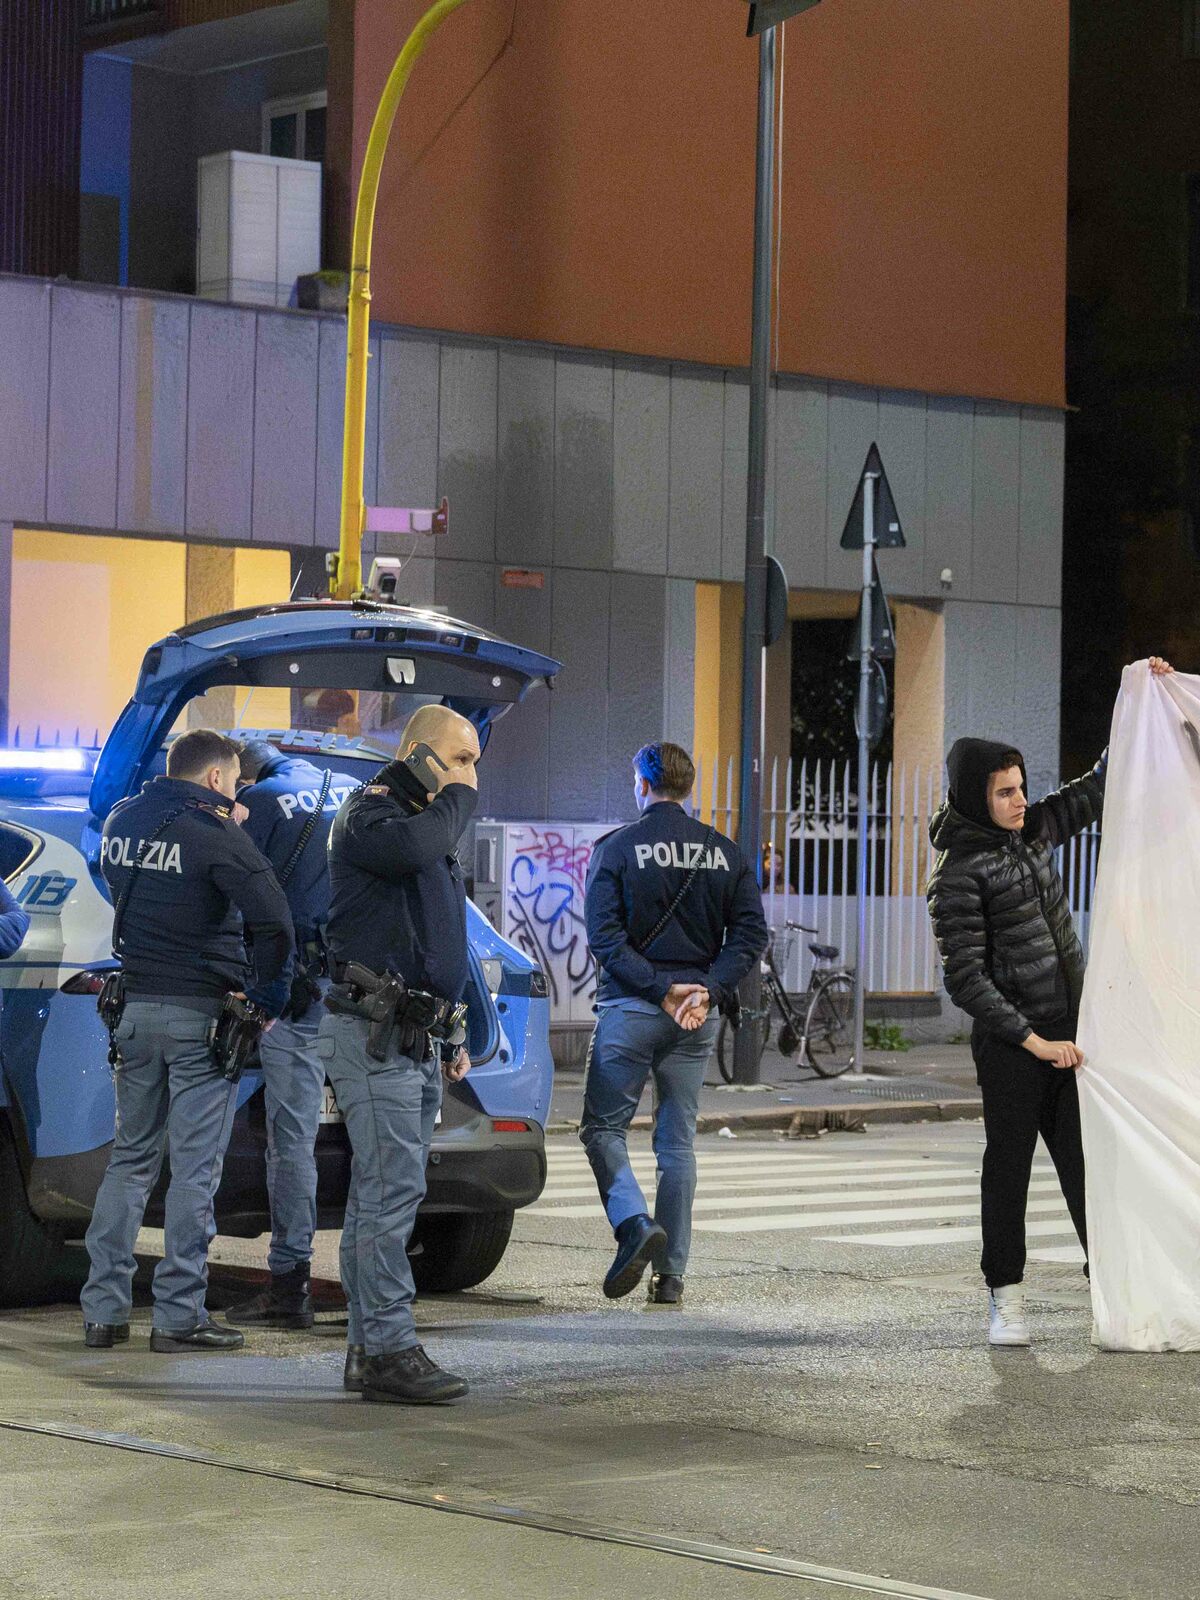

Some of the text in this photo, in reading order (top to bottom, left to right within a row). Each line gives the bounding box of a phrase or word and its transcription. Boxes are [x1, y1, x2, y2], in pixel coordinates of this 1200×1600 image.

[277, 786, 355, 820] POLIZ
[100, 836, 183, 874] POLIZIA
[634, 841, 730, 872] POLIZIA
[16, 874, 78, 906] 113
